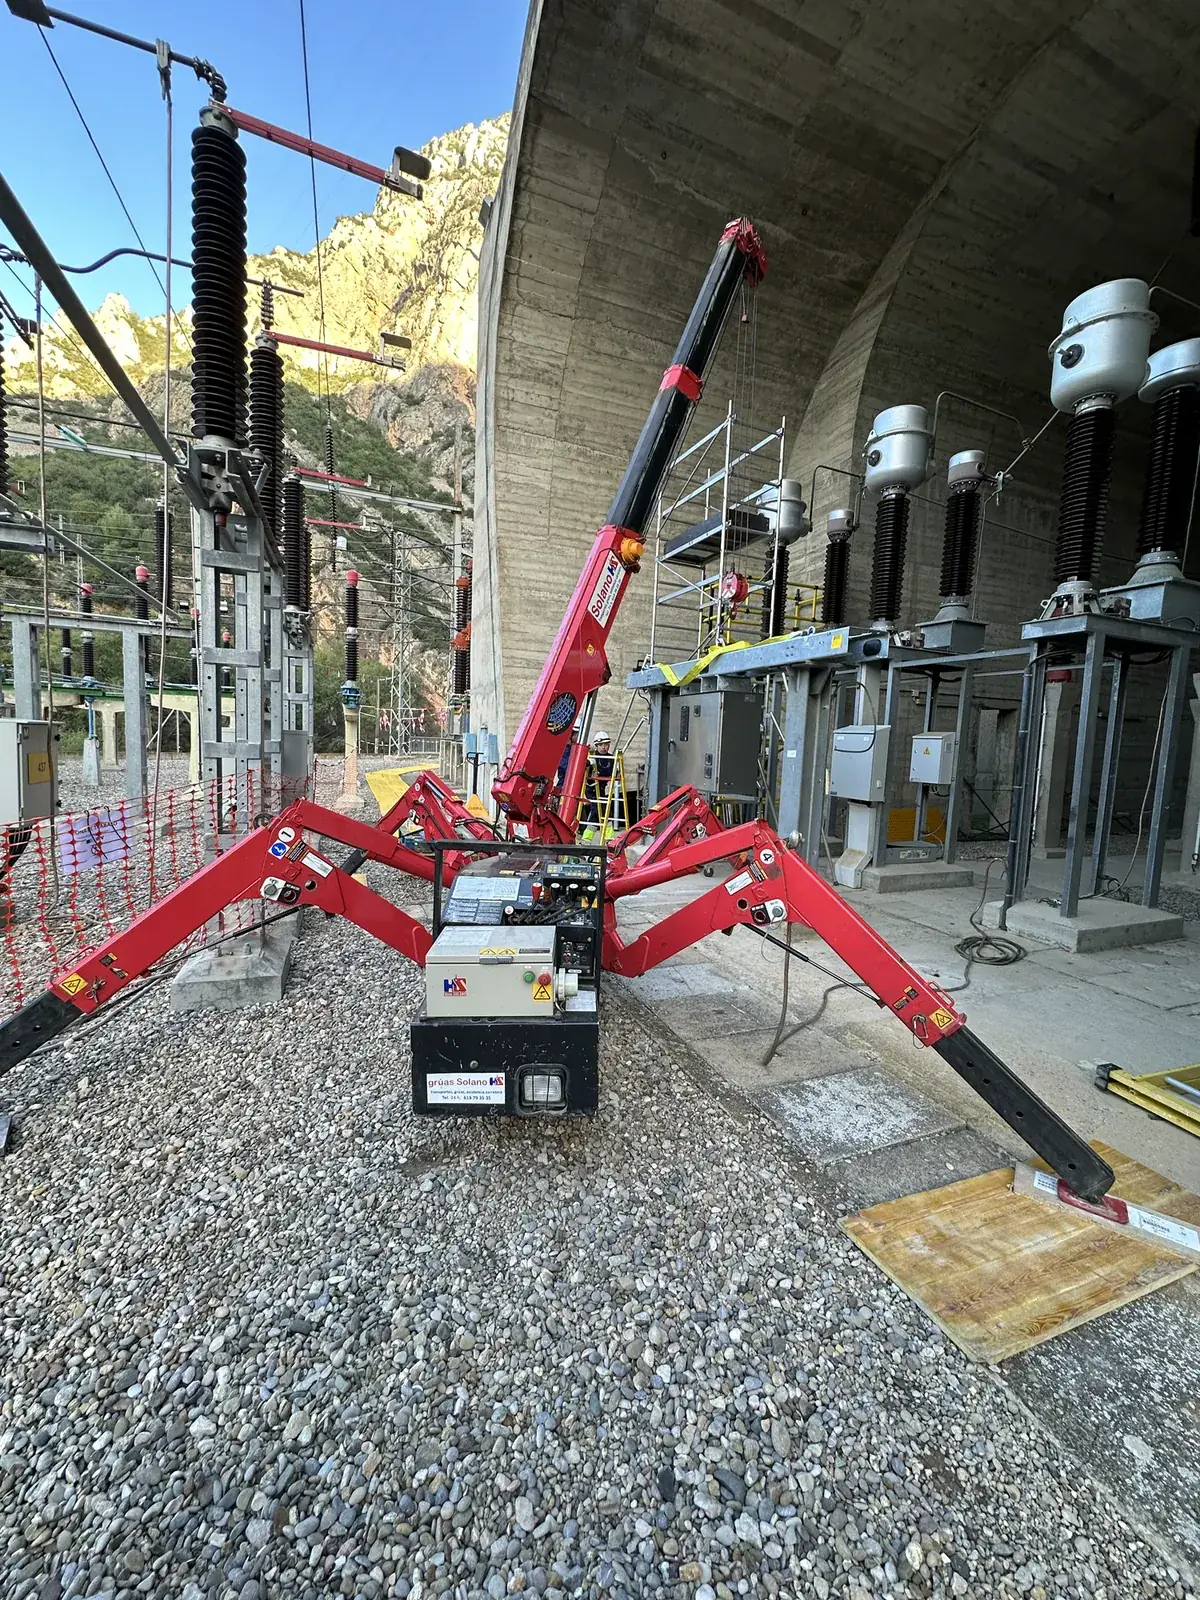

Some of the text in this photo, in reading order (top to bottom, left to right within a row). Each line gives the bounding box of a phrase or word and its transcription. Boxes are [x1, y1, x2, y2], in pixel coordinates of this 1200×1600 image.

[592, 575, 613, 618] Solano
[428, 1079, 455, 1088] grúas
[457, 1077, 488, 1086] Solano
